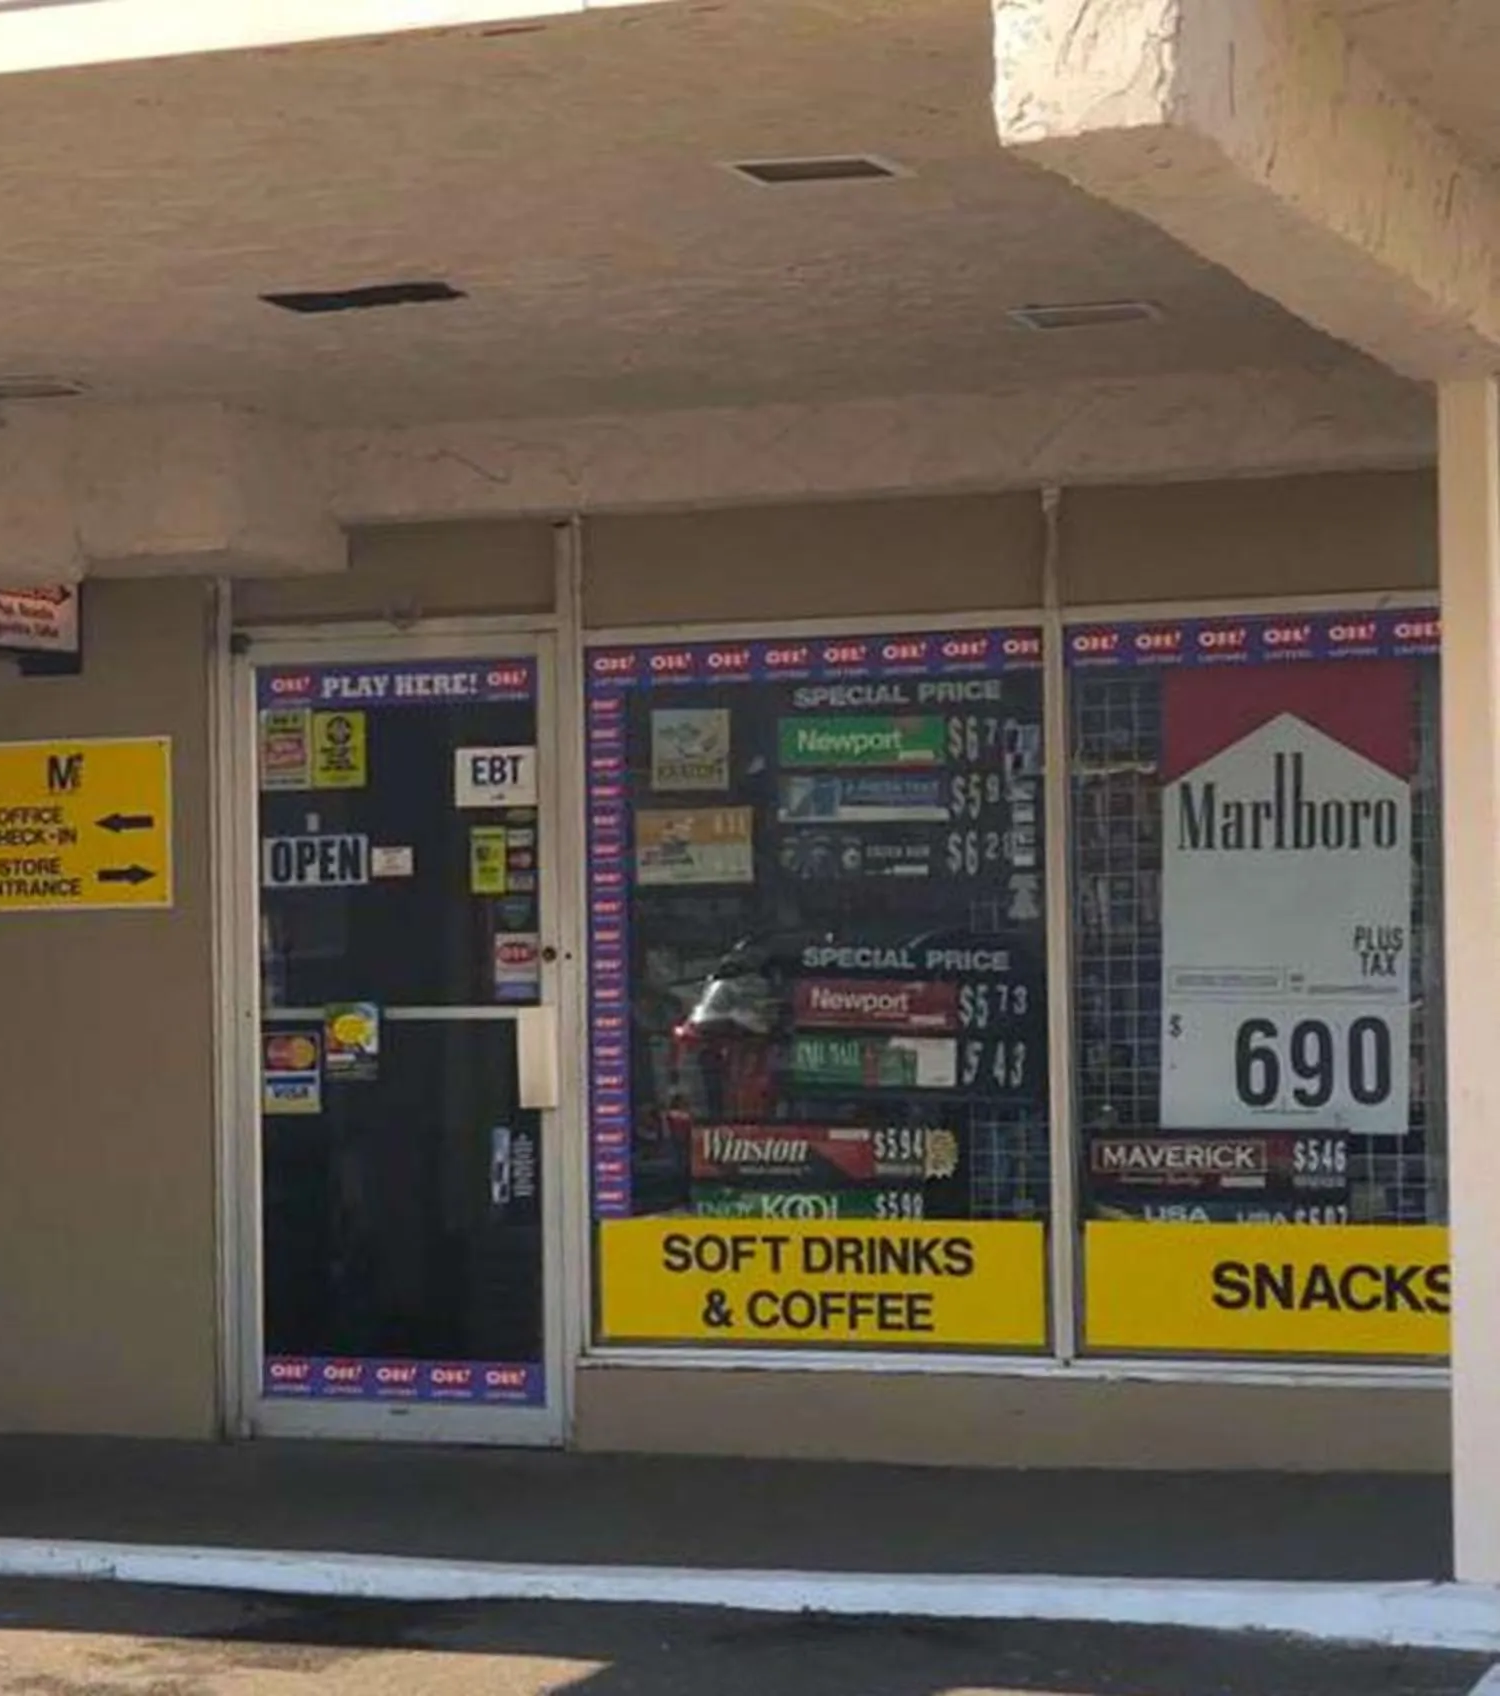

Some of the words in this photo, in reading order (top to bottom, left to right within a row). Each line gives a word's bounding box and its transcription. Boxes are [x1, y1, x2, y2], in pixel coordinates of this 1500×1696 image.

[320, 674, 389, 698] PLAY
[394, 672, 479, 696] HERE!
[793, 685, 910, 708] SPECIAL
[917, 678, 1001, 702] PRICE
[797, 729, 902, 755] Newport
[471, 755, 525, 787] EBT
[1177, 753, 1398, 851] Marlboro
[271, 837, 362, 883] OPEN
[1354, 925, 1404, 952] PLUS
[802, 948, 915, 970] SPECIAL
[925, 950, 1012, 971] PRICE
[1360, 950, 1397, 977] TAX
[811, 985, 910, 1014] Newport
[1235, 1016, 1392, 1108] 690
[702, 1128, 810, 1165] Winston
[1102, 1144, 1256, 1170] MAVERICK
[662, 1234, 790, 1274] SOFT
[802, 1236, 975, 1277] DRINKS
[1211, 1261, 1451, 1315] SNACKS
[702, 1288, 733, 1328] &
[746, 1290, 936, 1331] COFFEE
